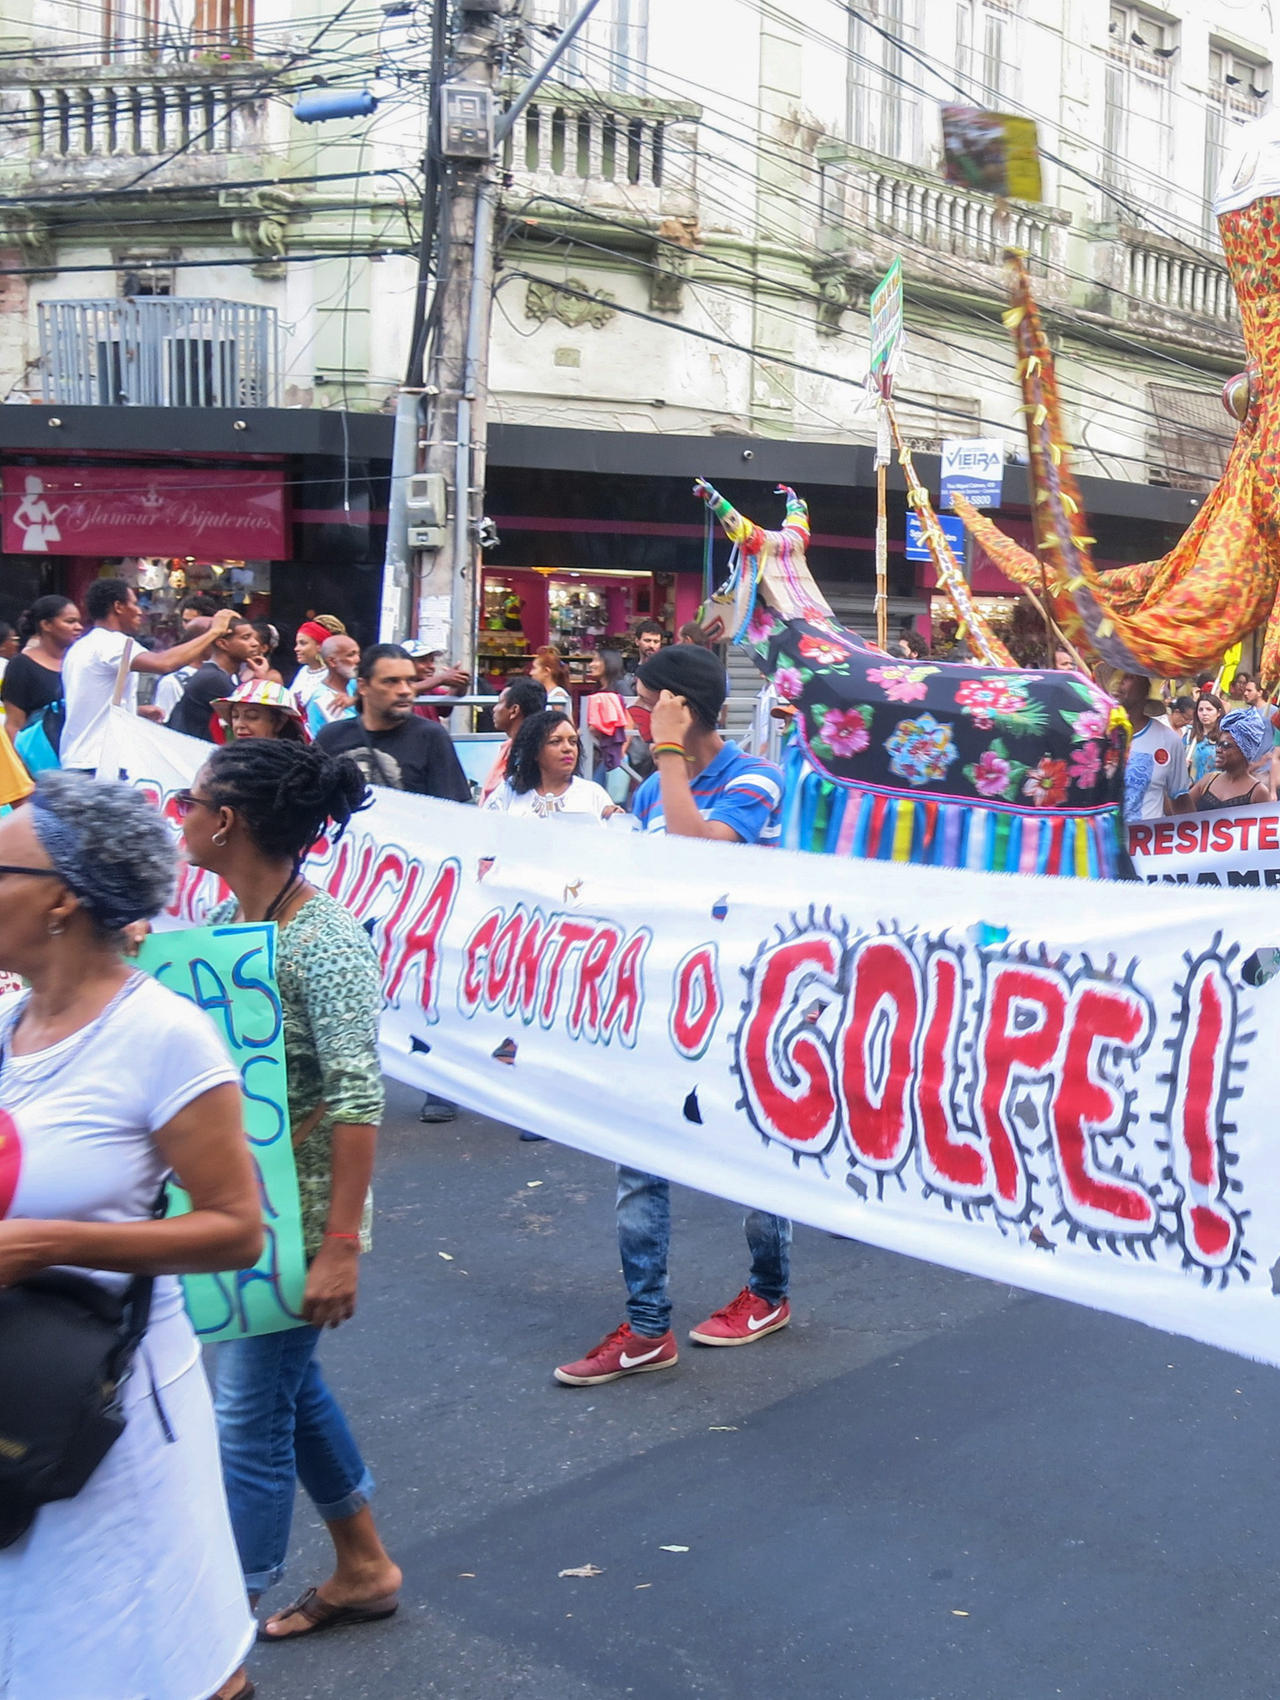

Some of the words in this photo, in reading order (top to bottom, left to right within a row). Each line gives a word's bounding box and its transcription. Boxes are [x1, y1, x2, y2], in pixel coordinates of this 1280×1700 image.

[946, 448, 1000, 471] VIEIRA
[66, 499, 162, 533] Glamour
[166, 501, 280, 537] Bijuterias
[459, 903, 652, 1048] CONTRA
[669, 941, 722, 1060] O
[734, 920, 1250, 1278] GOLPE!
